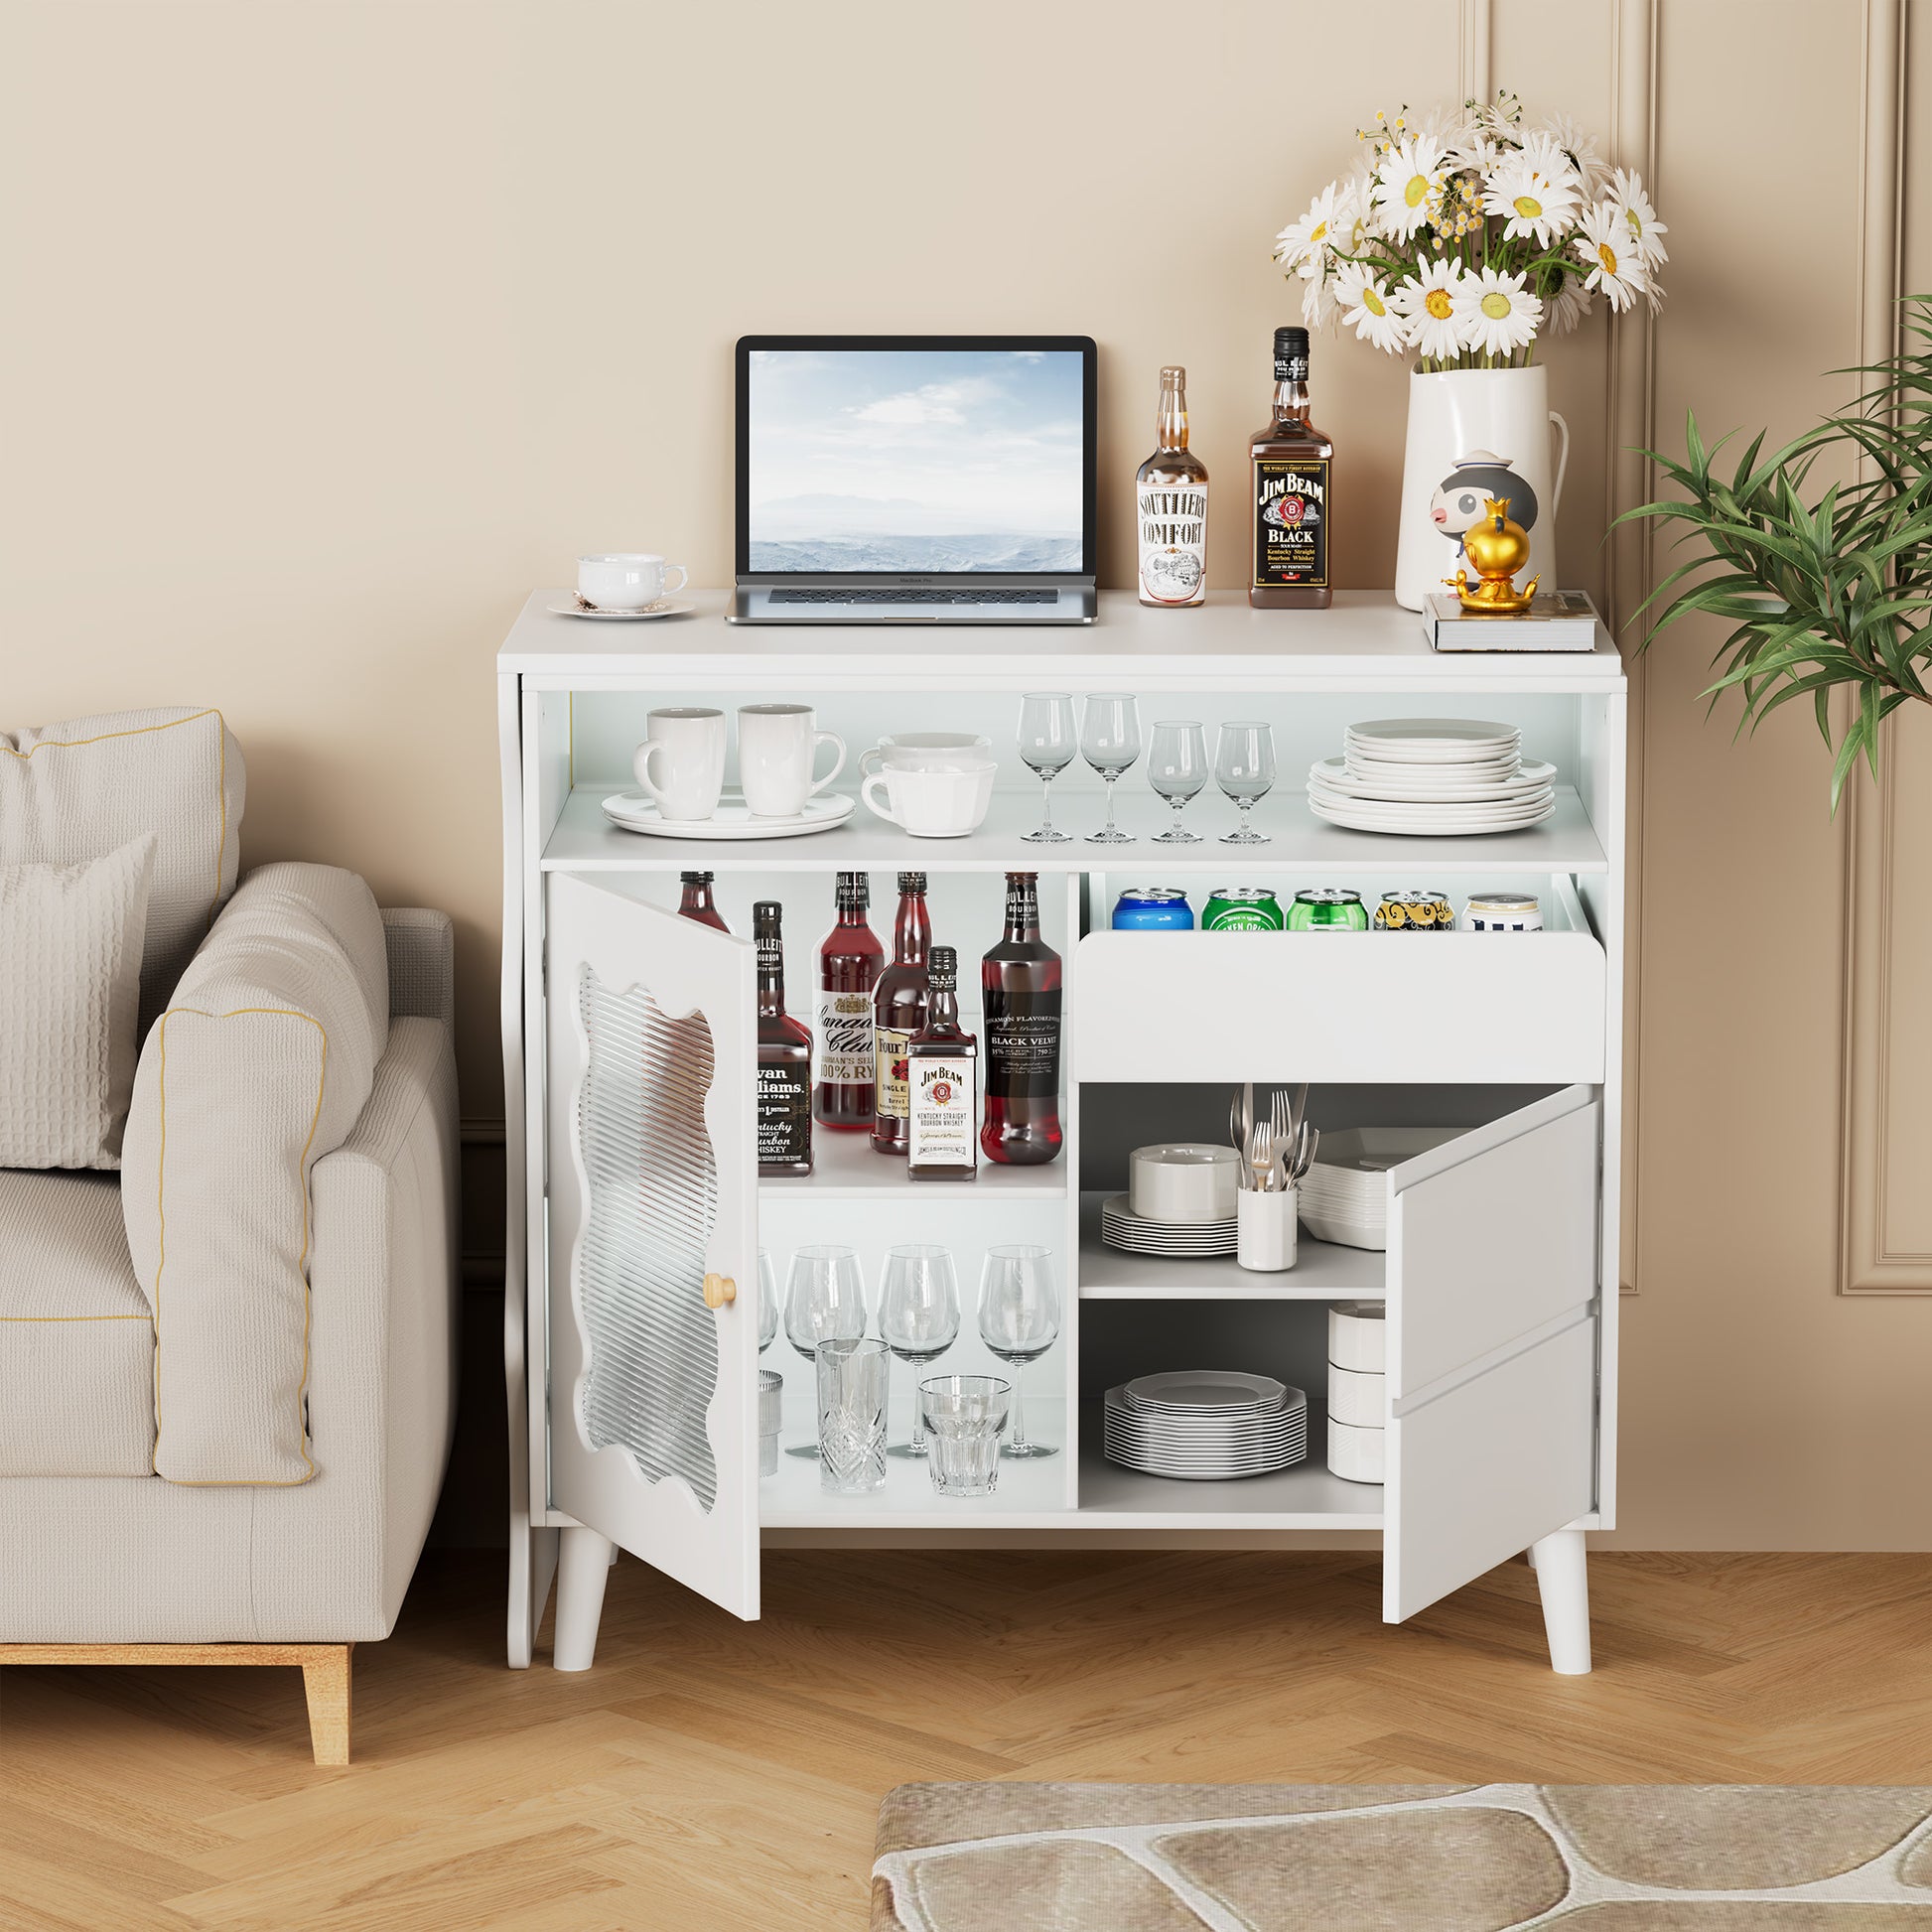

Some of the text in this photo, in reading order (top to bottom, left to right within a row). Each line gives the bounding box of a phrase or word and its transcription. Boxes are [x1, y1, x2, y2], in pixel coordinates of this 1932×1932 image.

[1258, 473, 1324, 505] JIM BEAM
[1143, 521, 1202, 545] COMFORT
[1268, 528, 1314, 543] BLACK
[991, 1035, 1056, 1045] BLACK VELVET
[758, 1069, 787, 1079] van
[921, 1066, 963, 1087] JIM BEAM
[758, 1080, 804, 1093] liams.
[759, 1136, 790, 1146] urbon
